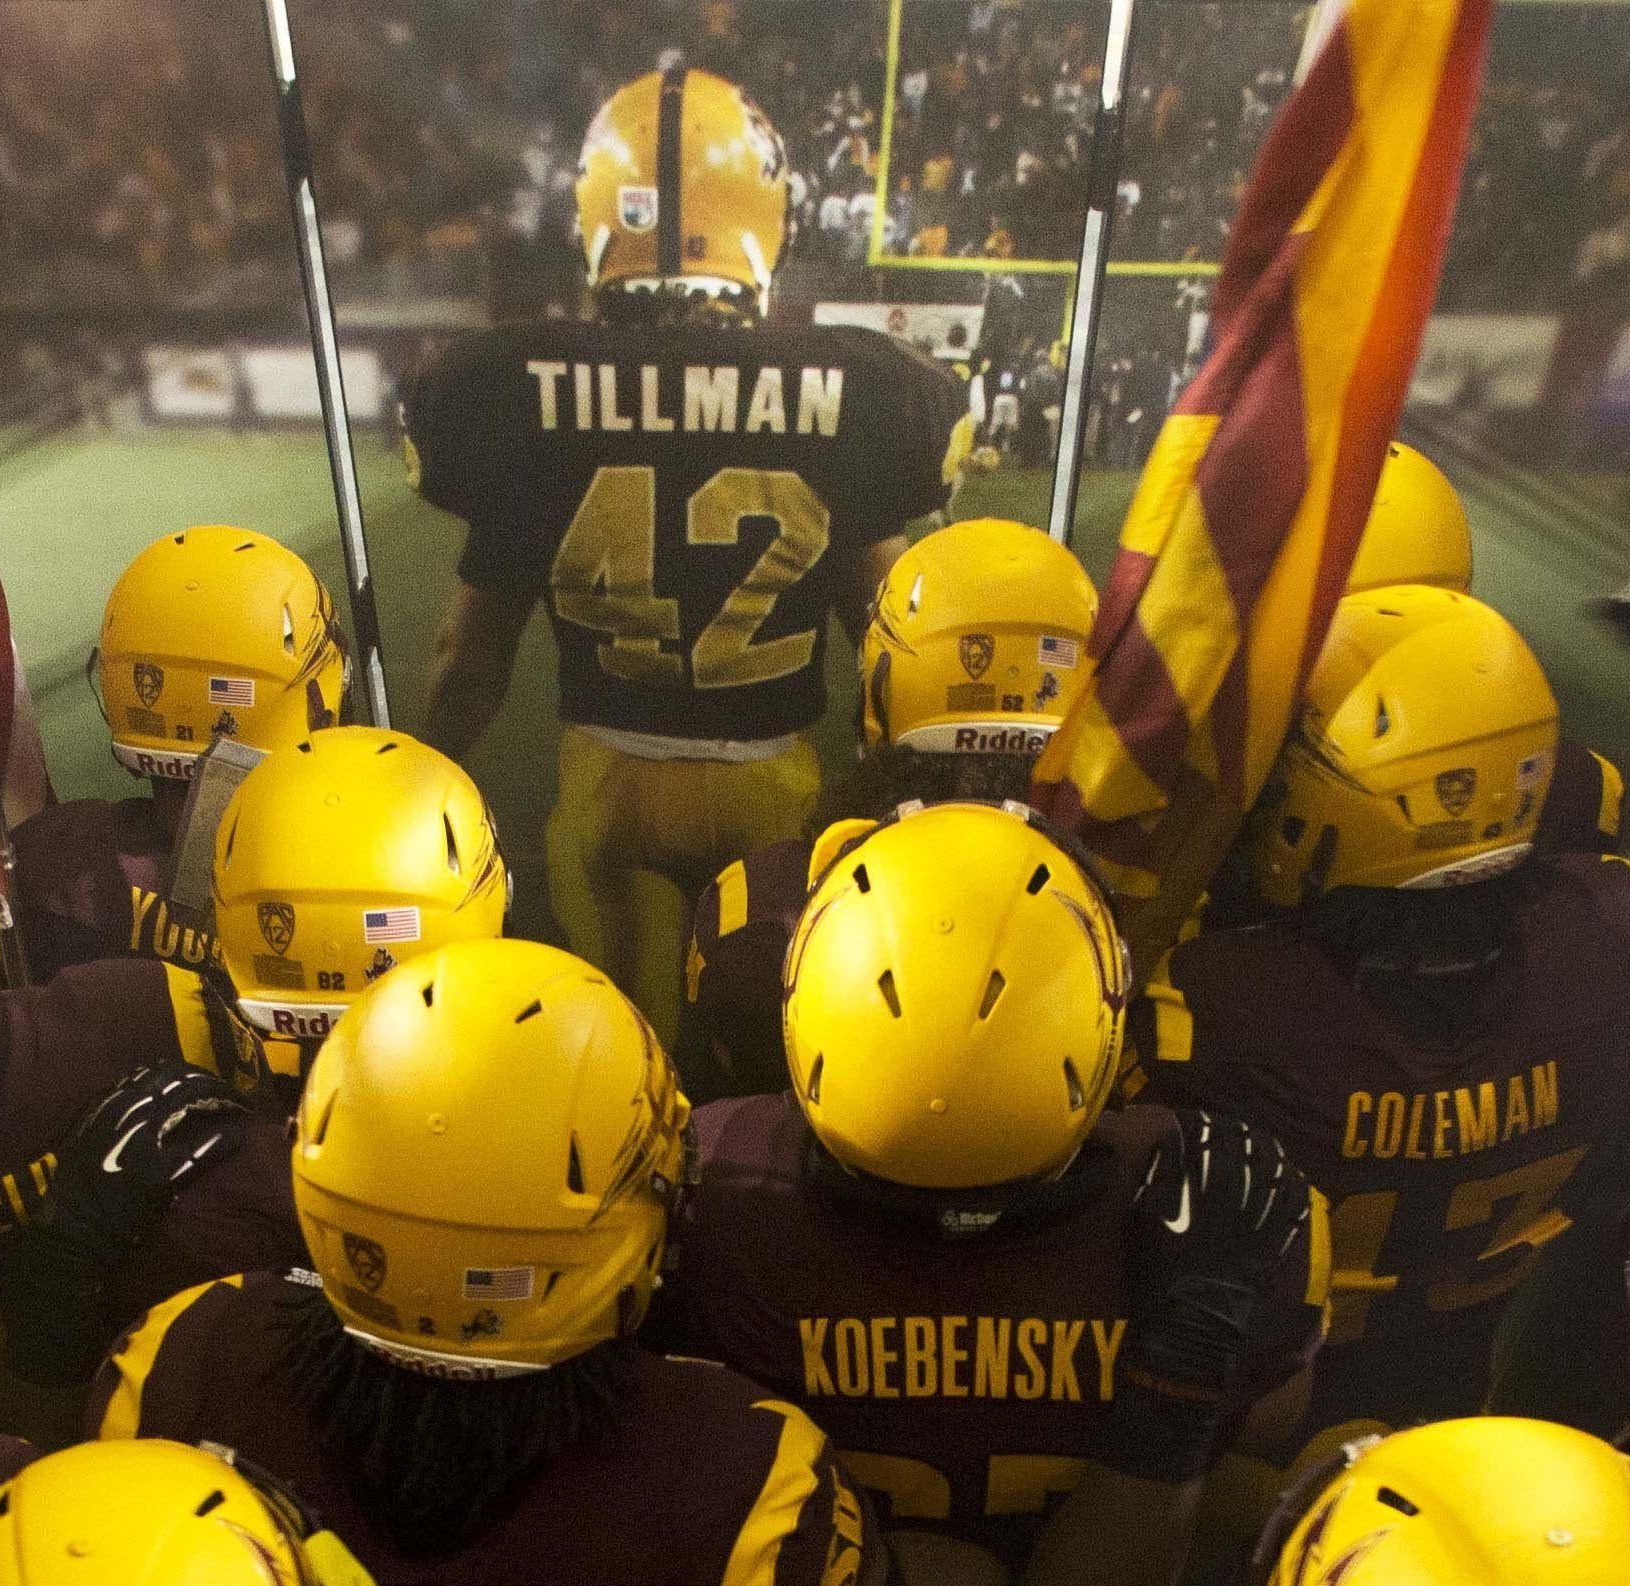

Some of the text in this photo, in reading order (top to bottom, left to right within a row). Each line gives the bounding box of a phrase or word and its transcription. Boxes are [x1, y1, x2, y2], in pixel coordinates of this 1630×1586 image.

[526, 360, 844, 436] TILLMAN
[550, 465, 832, 690] 42
[135, 752, 199, 778] Ridd
[954, 728, 1052, 752] Ridde
[1341, 1059, 1559, 1160] COLEMAN
[798, 1314, 1130, 1402] KOEBENSKY
